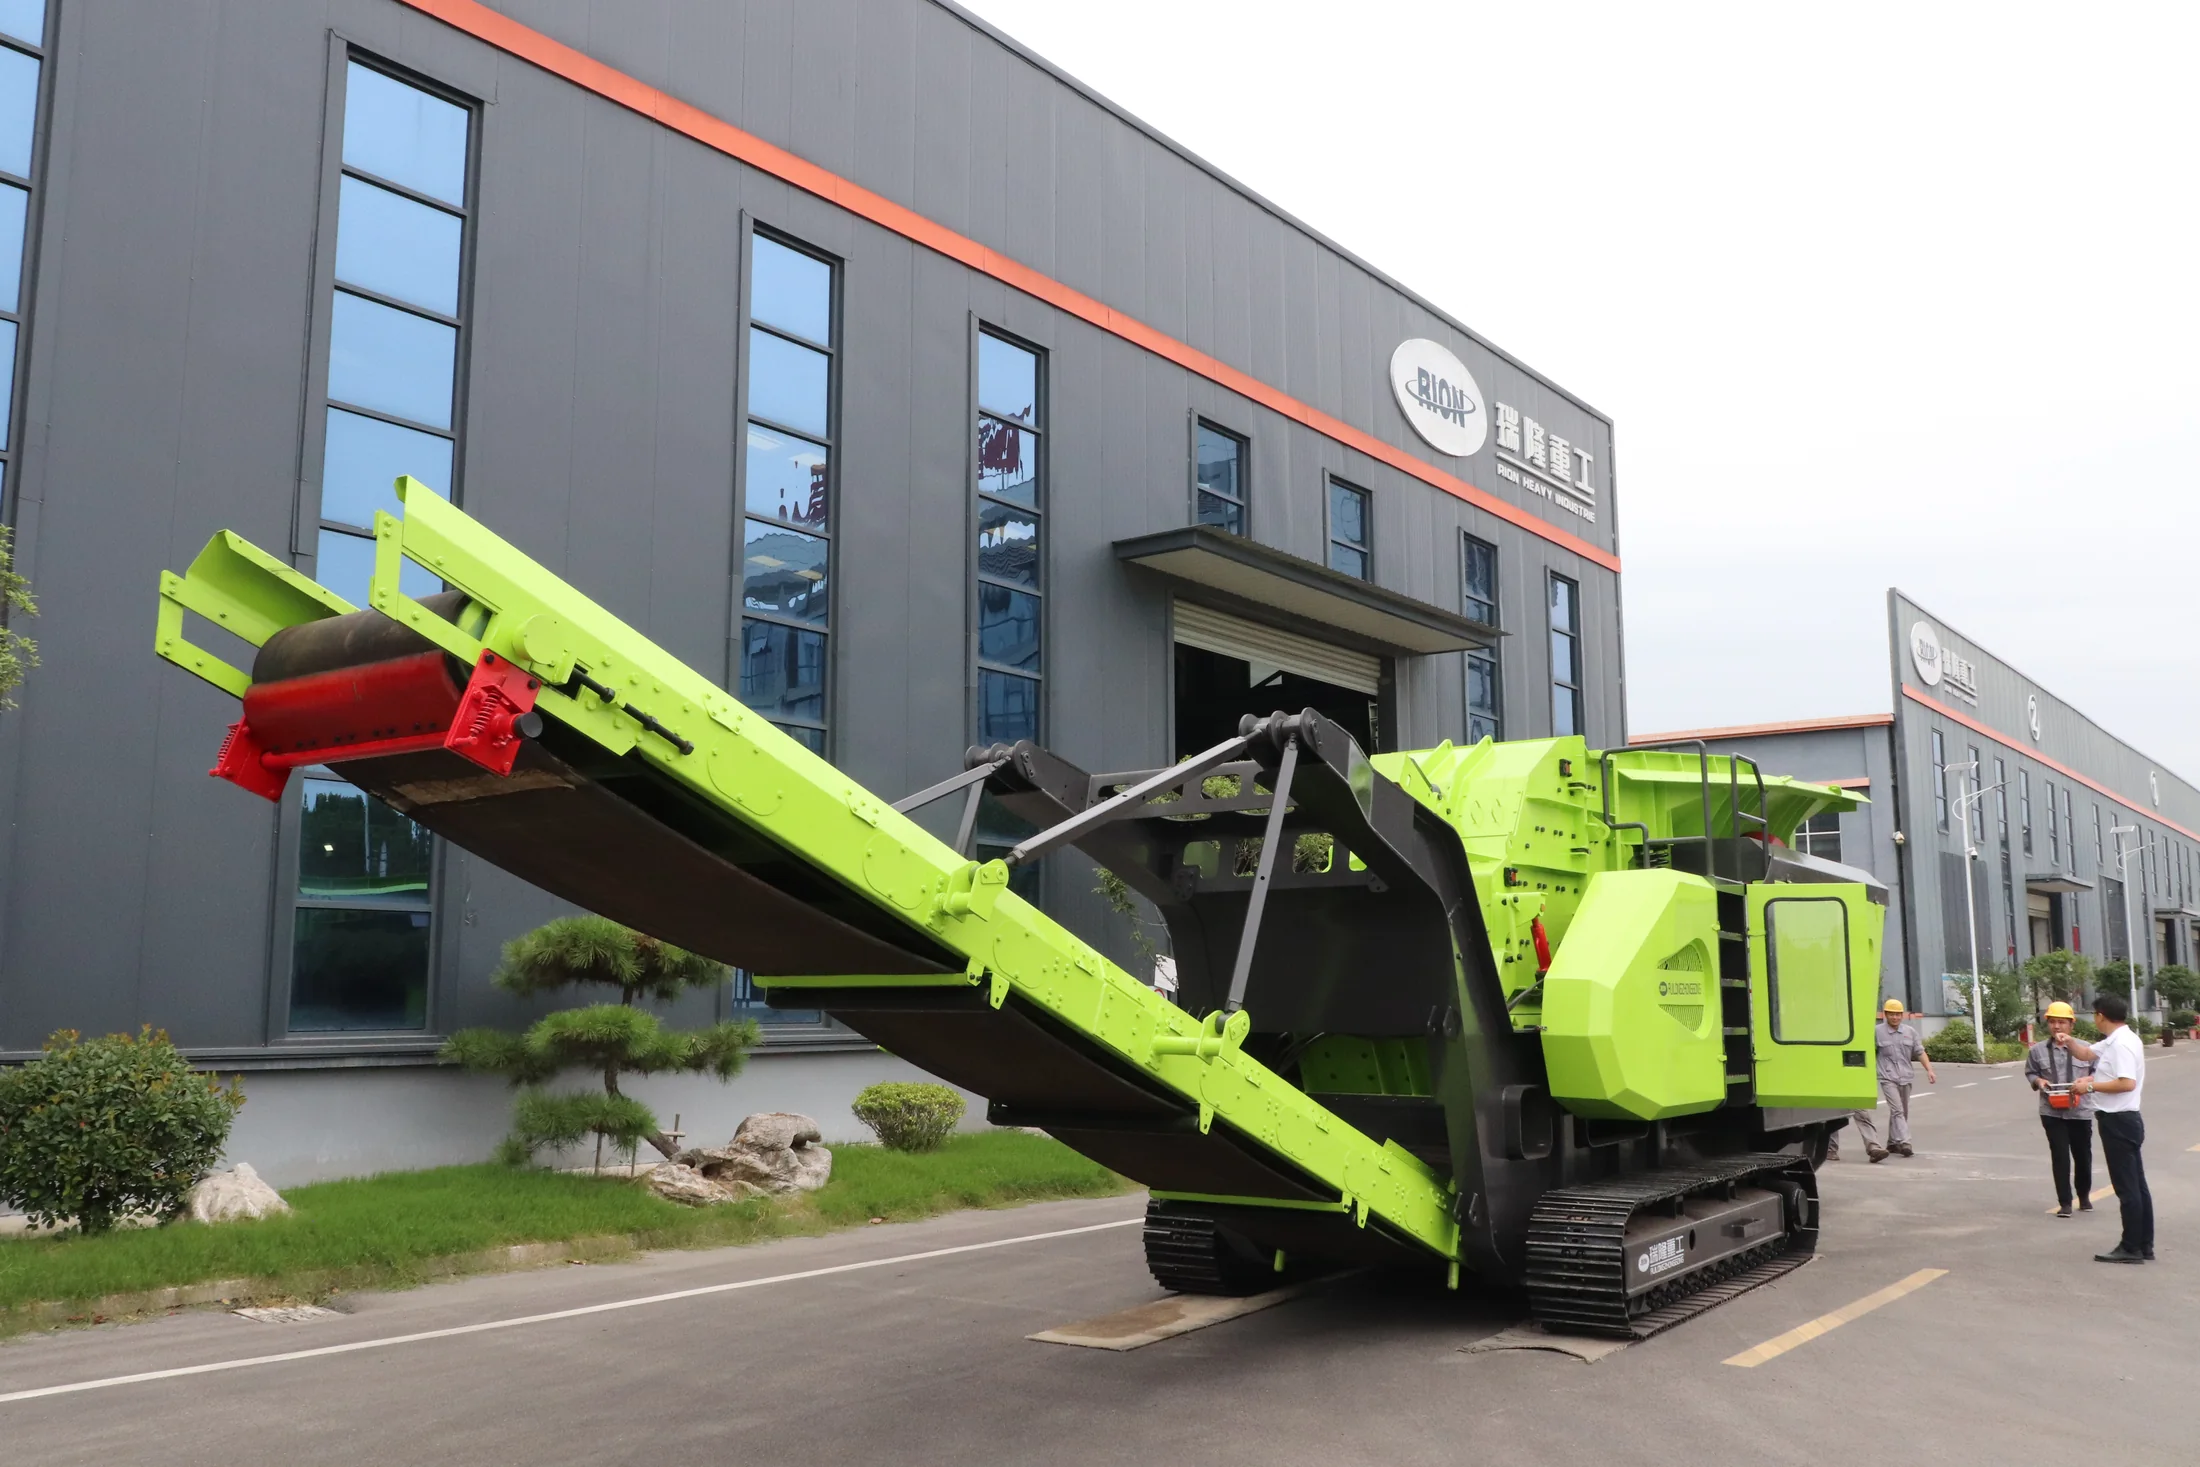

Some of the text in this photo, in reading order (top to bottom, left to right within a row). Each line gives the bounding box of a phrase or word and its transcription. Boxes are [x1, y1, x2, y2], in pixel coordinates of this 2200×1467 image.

[1417, 366, 1465, 428] RION
[1496, 401, 1595, 495] 瑞隆重工
[1497, 463, 1595, 523] RION HEAVY INDUSTRIE
